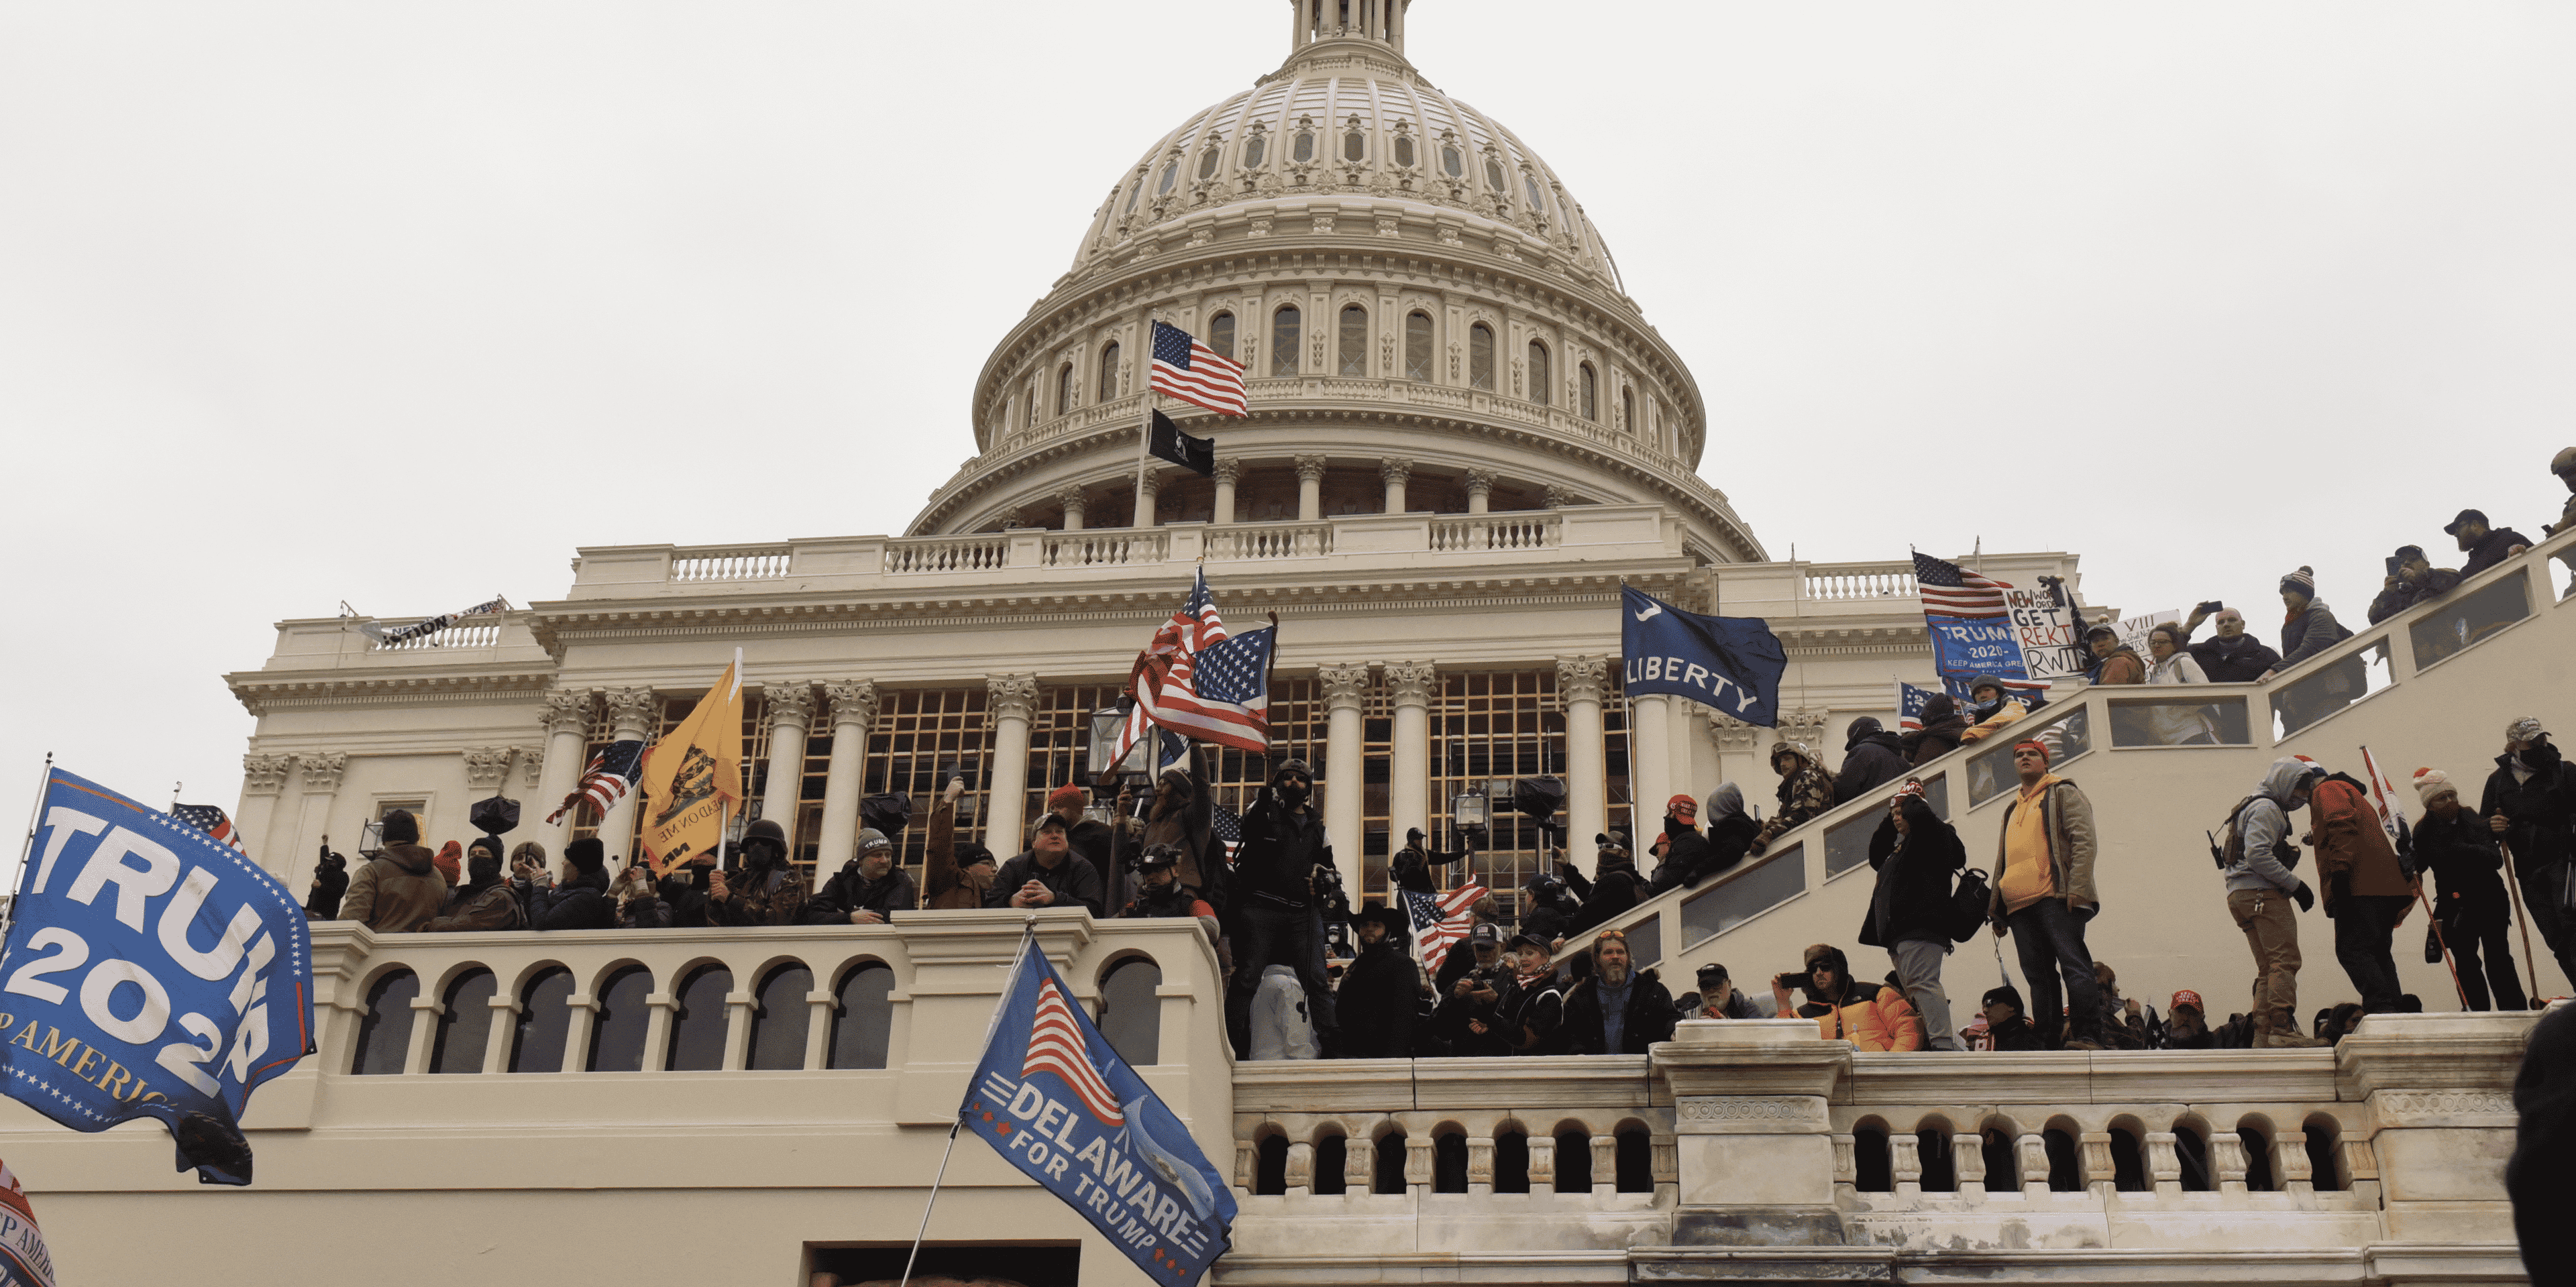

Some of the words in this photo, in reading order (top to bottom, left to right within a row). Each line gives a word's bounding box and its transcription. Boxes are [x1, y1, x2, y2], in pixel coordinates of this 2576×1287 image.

[2006, 589, 2034, 609] NEW
[2013, 608, 2060, 626] GET
[2124, 615, 2154, 631] VIII
[2020, 624, 2071, 647] REKT
[1947, 659, 1968, 667] KEEP
[1969, 661, 2002, 669] AMERICA
[2004, 659, 2024, 668] GRE
[1626, 657, 1758, 714] LIBERTY
[865, 838, 888, 849] TRUMP
[3, 927, 221, 1099] 202
[9, 1019, 168, 1103] AMERI
[1007, 1081, 1198, 1246] DELAWARE
[1008, 1129, 1069, 1182] FOR
[1074, 1172, 1157, 1249] TRUMP
